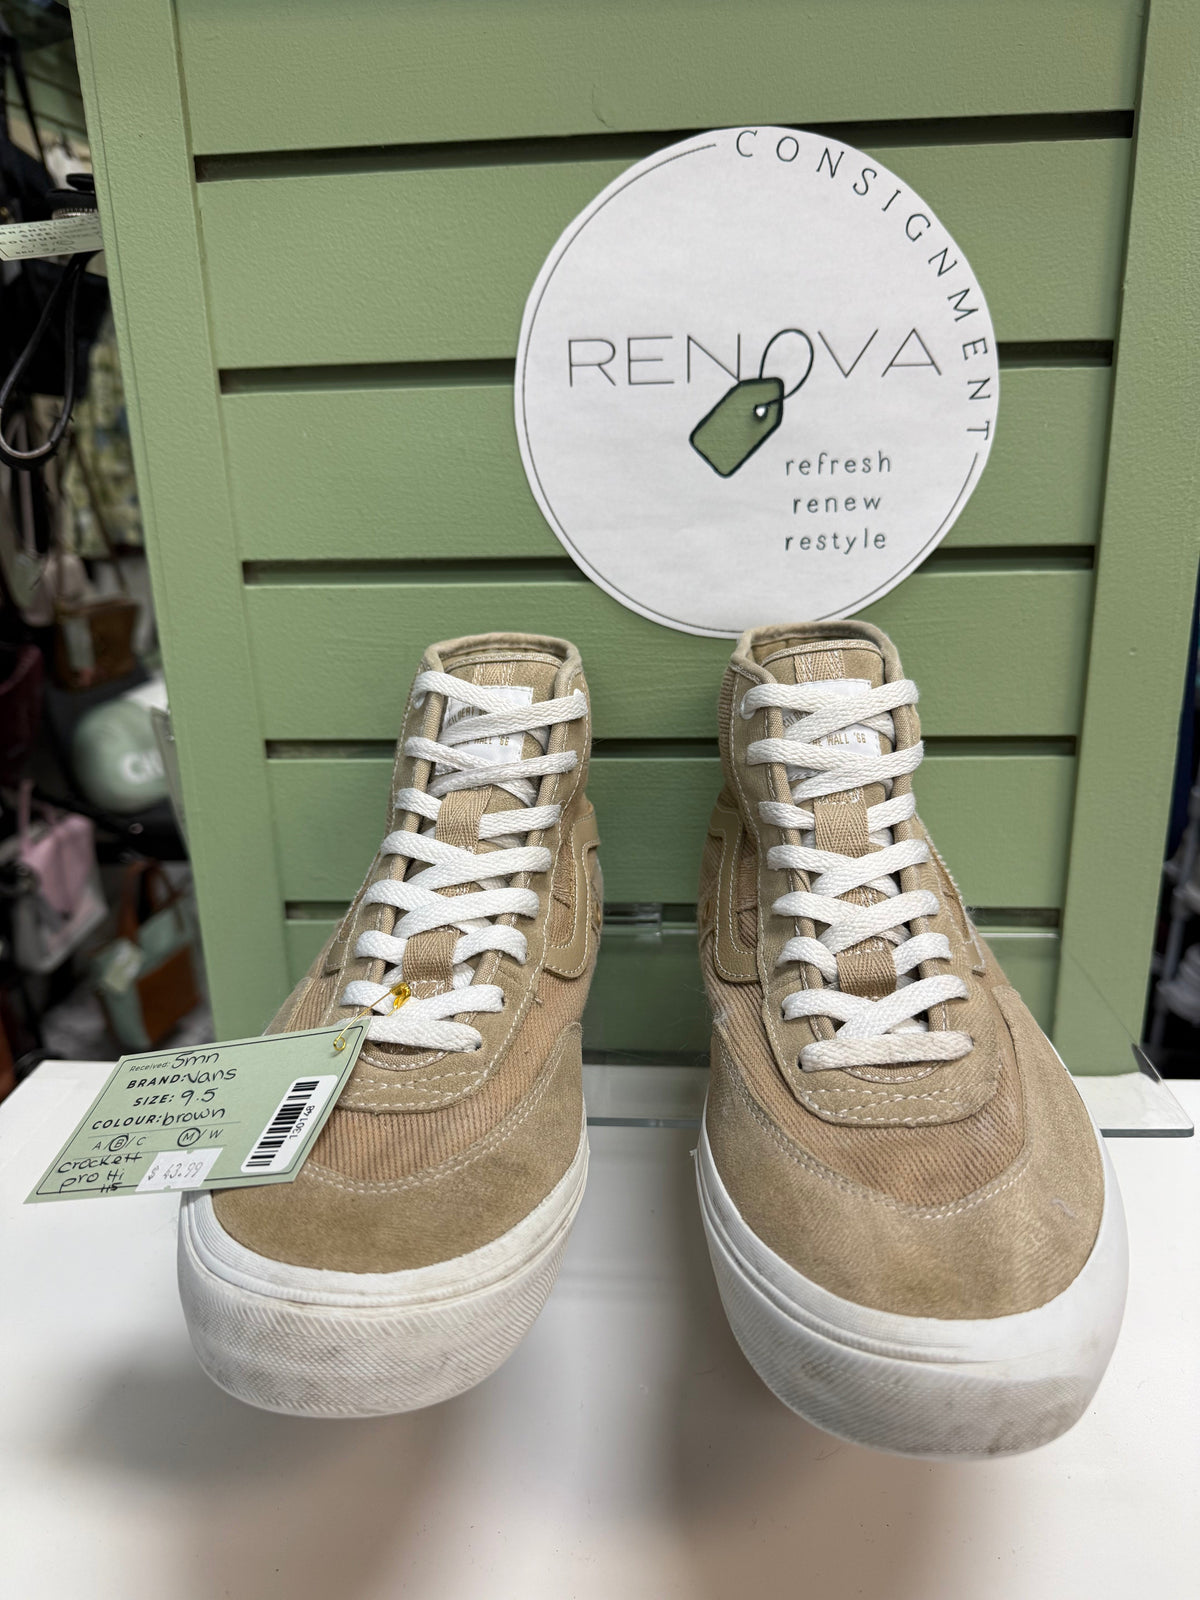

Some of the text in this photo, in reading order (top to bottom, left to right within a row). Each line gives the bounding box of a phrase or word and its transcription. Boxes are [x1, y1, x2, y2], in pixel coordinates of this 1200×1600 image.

[735, 129, 992, 441] CONSIGNMENT
[568, 328, 943, 388] RENOVA
[785, 451, 893, 476] refresh
[793, 494, 882, 514] renew
[785, 528, 888, 555] restyle
[827, 733, 850, 746] WALL
[129, 1062, 171, 1073] Received:
[126, 1074, 186, 1090] BRAND:
[132, 1088, 219, 1107] SIZE: 9.5
[92, 1108, 226, 1130] COLOUR: brown
[289, 1105, 316, 1140] 130148
